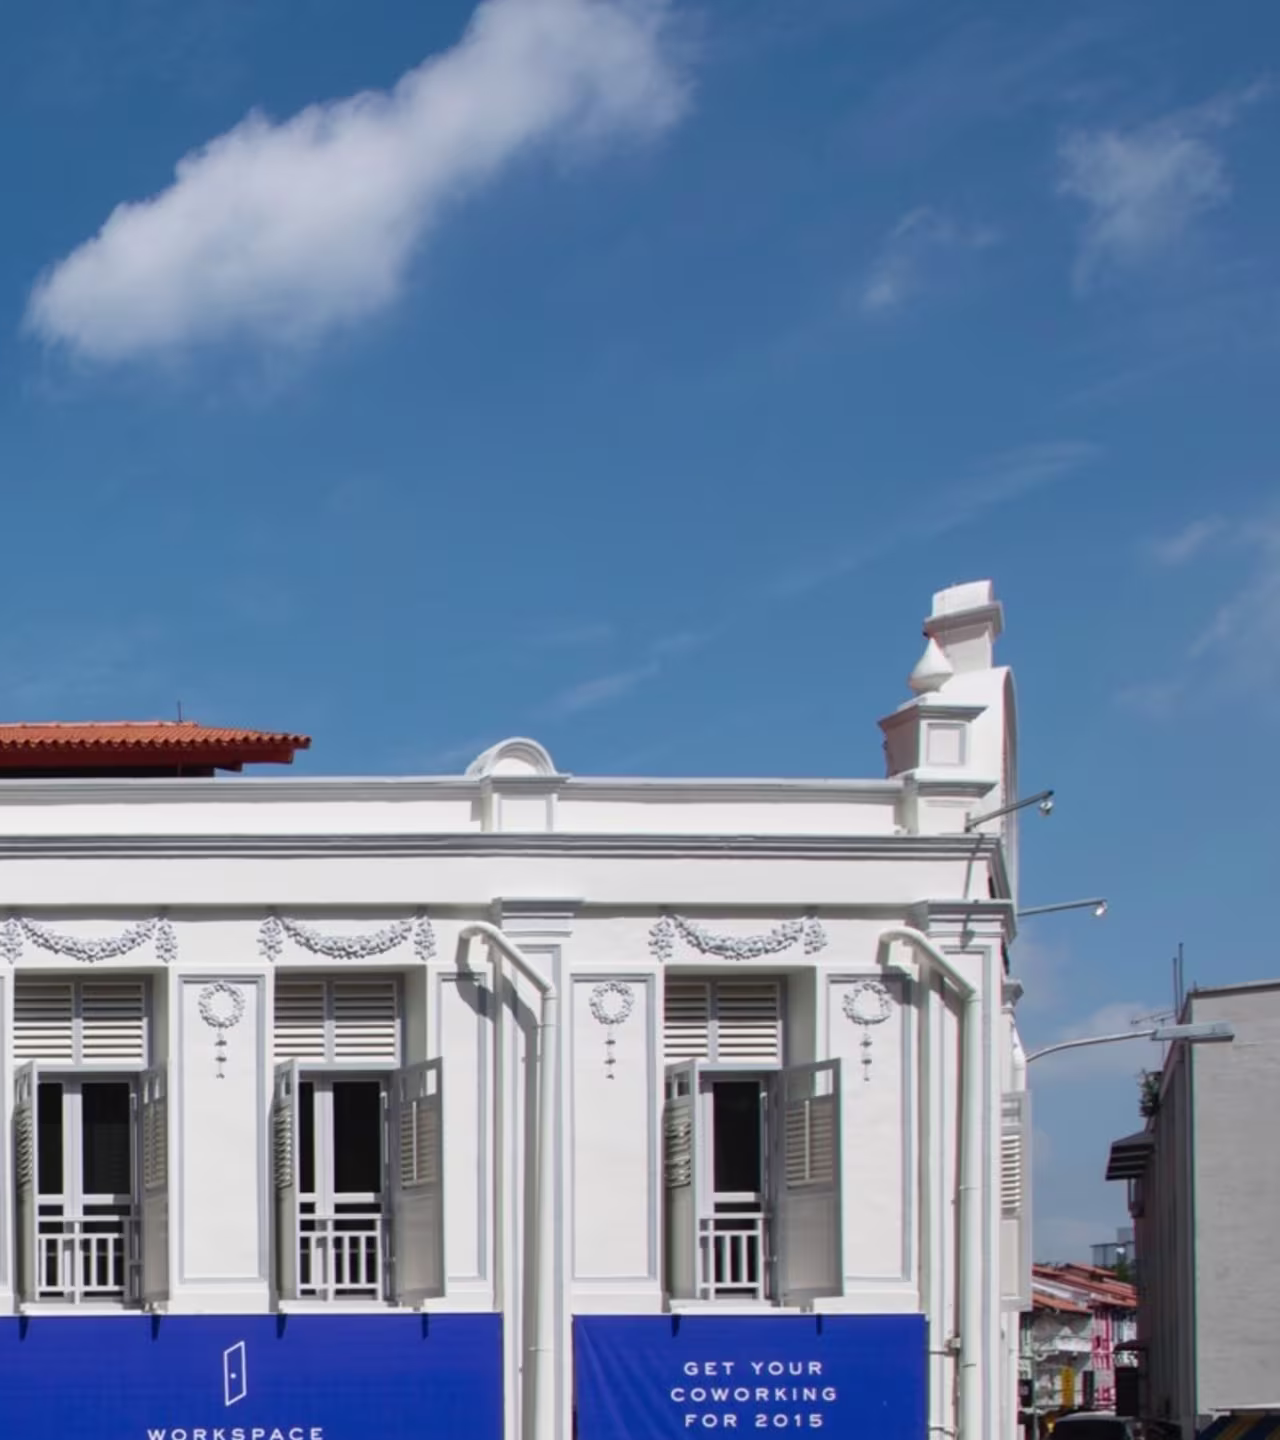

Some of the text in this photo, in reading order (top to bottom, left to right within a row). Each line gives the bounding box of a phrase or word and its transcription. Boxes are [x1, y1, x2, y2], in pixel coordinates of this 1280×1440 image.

[683, 1360, 823, 1377] GET YOUR
[670, 1386, 837, 1403] COWORKING
[684, 1413, 824, 1429] FOR 2015
